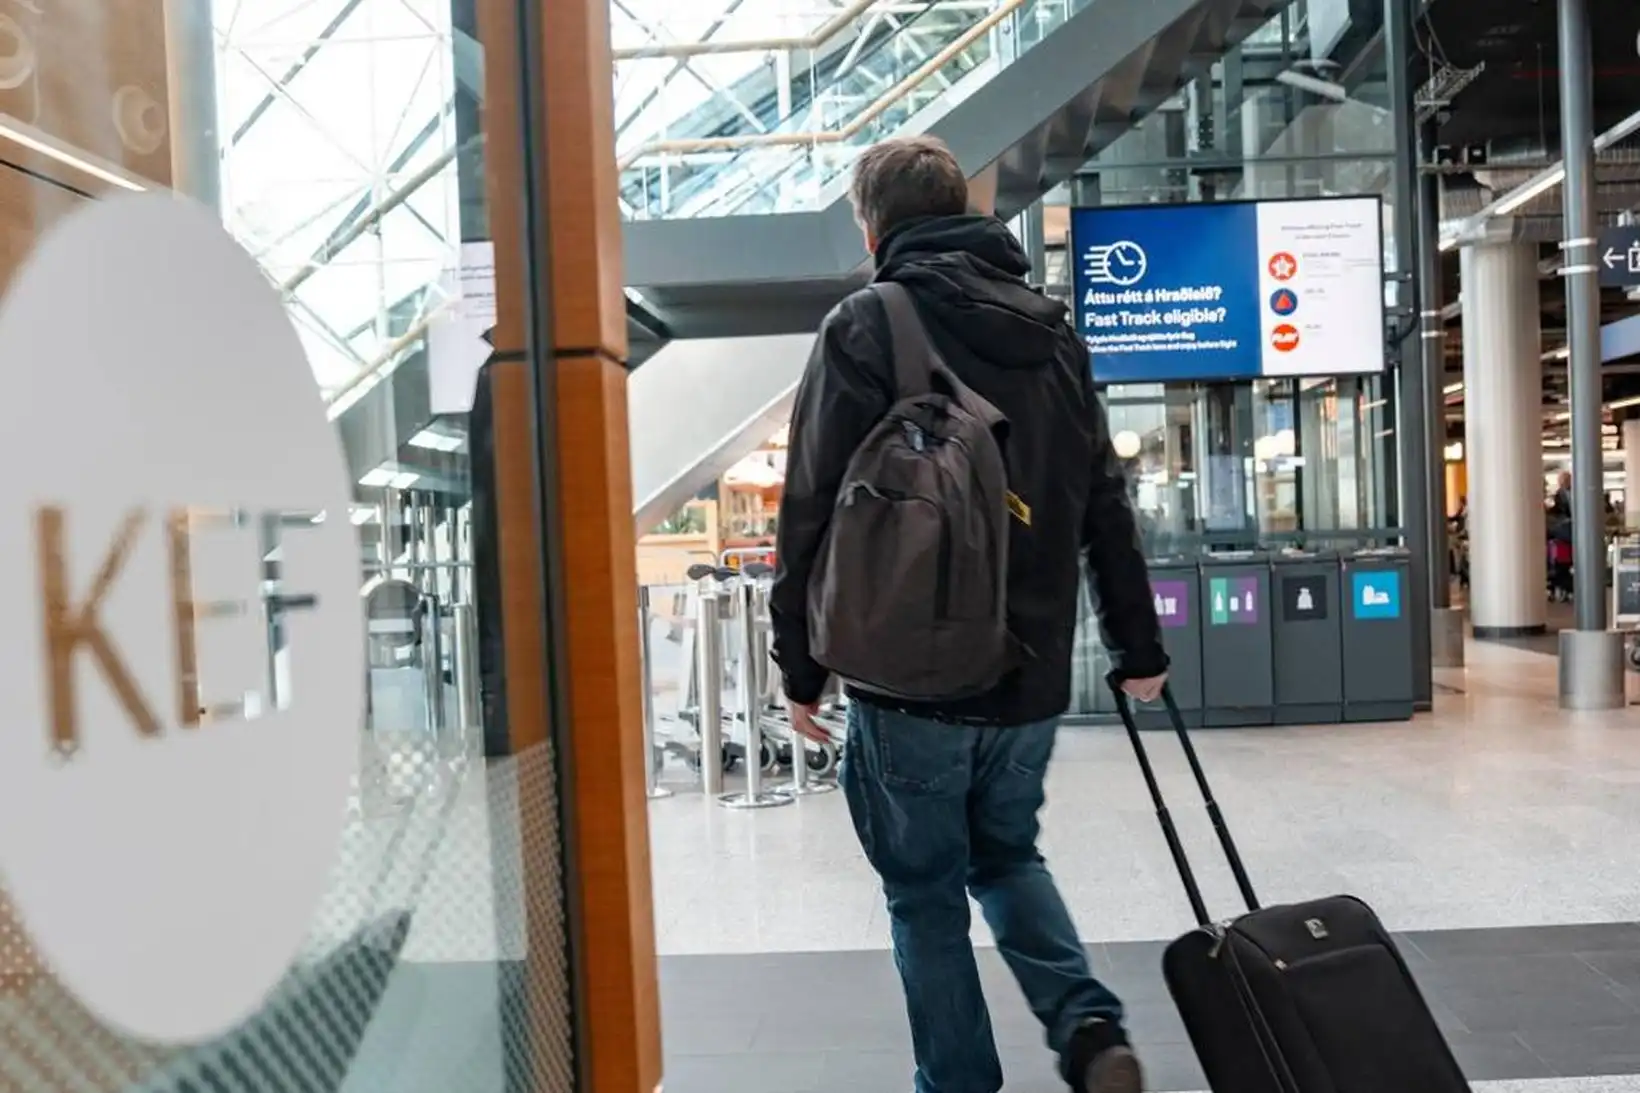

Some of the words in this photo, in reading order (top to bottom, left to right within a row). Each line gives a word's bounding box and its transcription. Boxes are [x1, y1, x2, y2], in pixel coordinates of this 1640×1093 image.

[1084, 288, 1115, 305] Áttu
[1085, 312, 1118, 327] Fast
[1119, 309, 1162, 326] Track
[1163, 307, 1226, 327] eligible?
[36, 502, 327, 746] KEF
